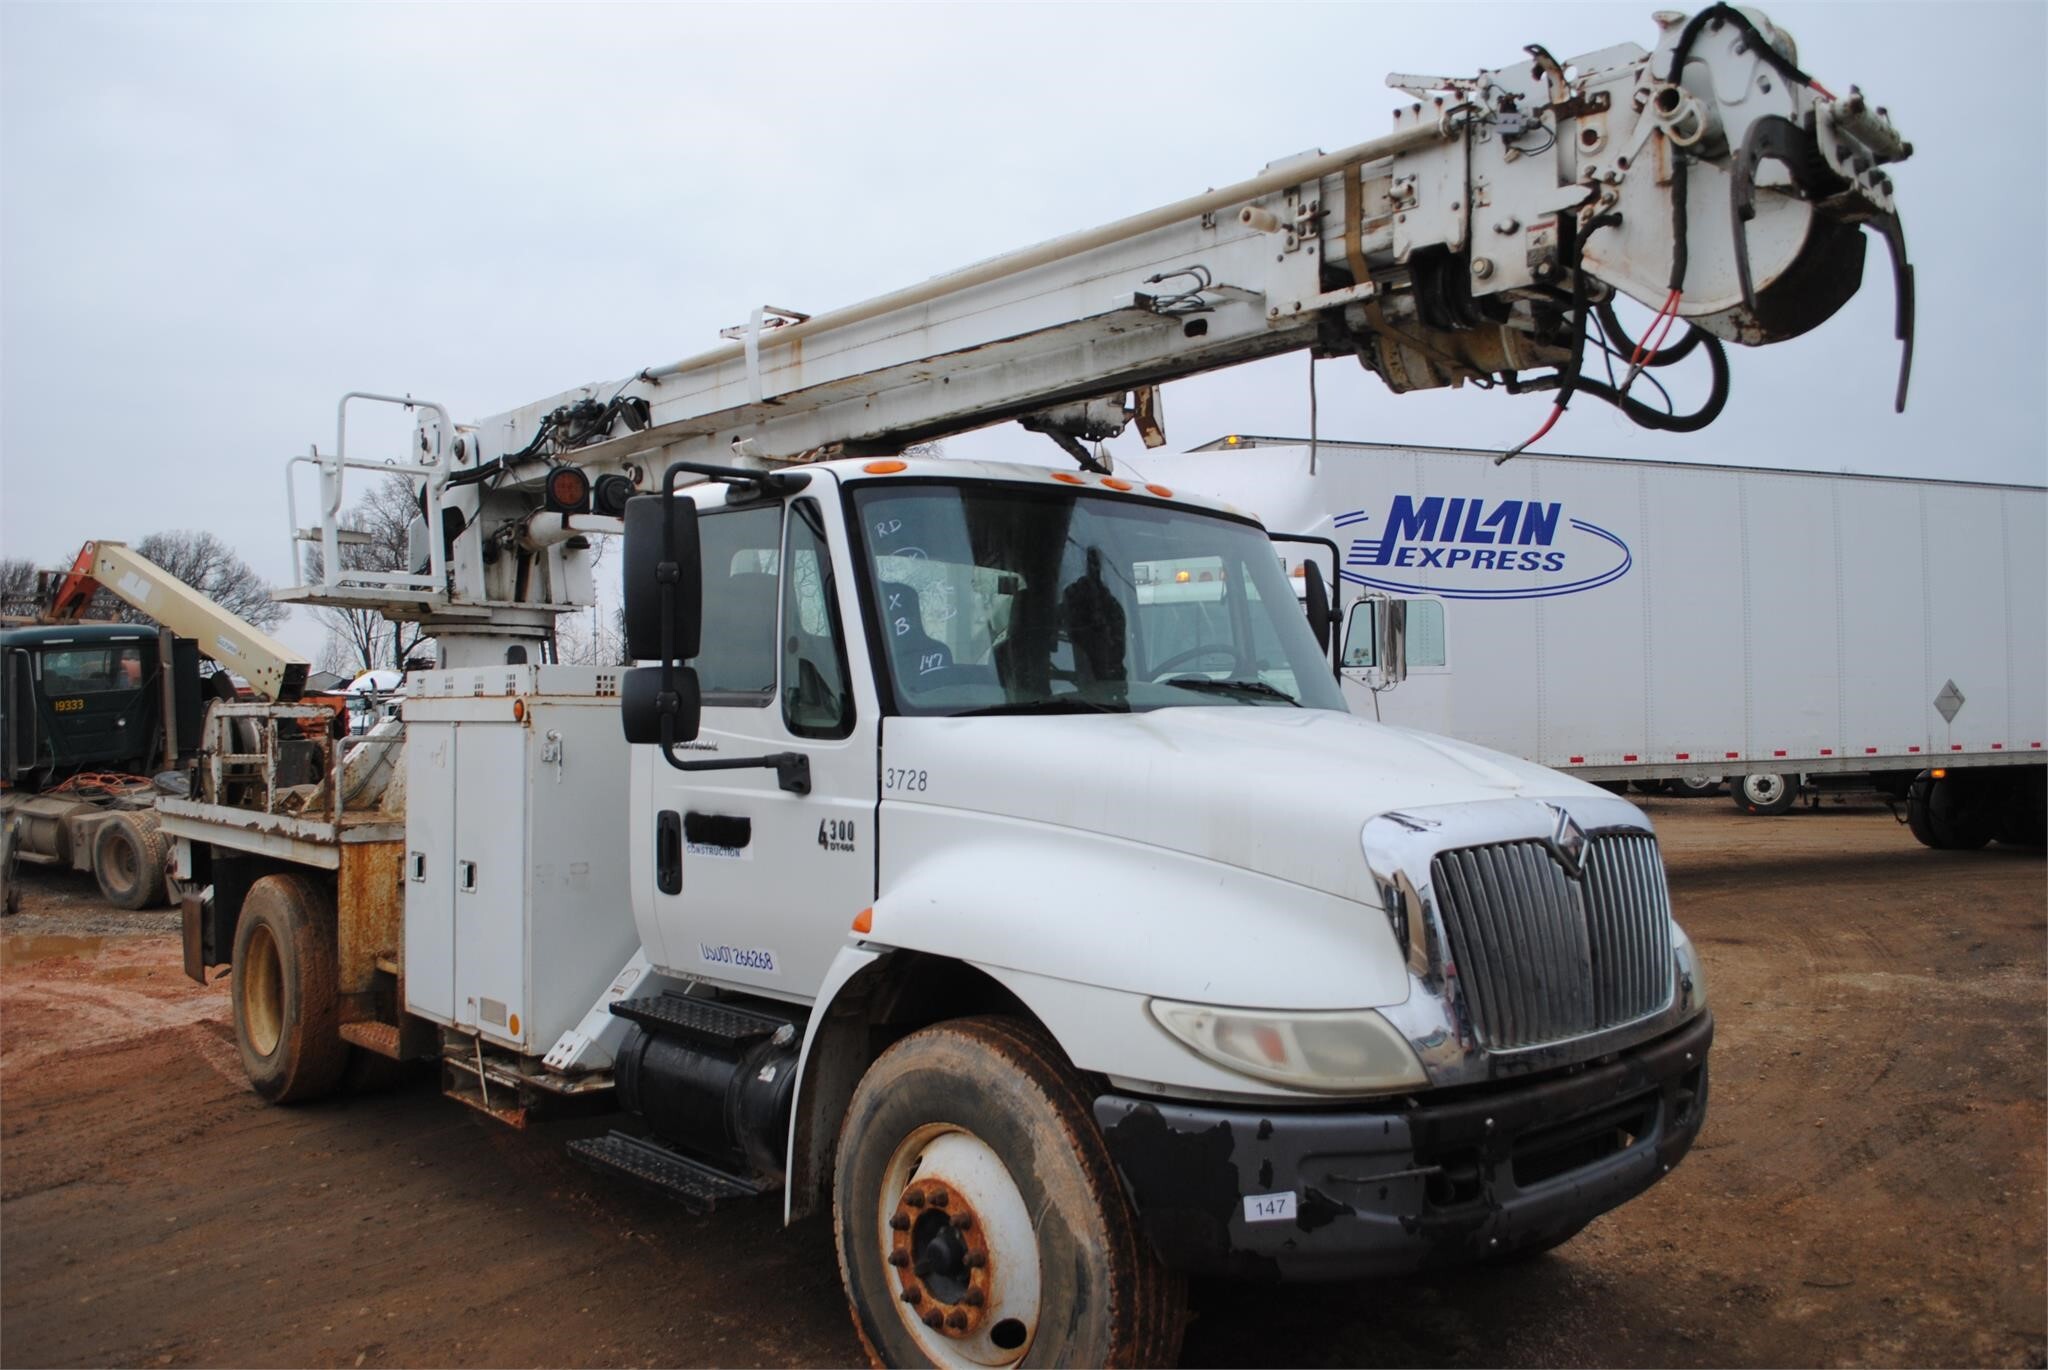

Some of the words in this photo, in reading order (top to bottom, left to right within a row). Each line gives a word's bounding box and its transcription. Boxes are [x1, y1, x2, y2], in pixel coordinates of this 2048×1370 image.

[1376, 495, 1561, 565] MILAN
[1394, 546, 1566, 572] EXPRESS
[894, 616, 911, 636] B
[919, 652, 943, 671] 147
[55, 699, 84, 712] 19333
[885, 768, 928, 792] 3728
[818, 817, 855, 850] 4300
[687, 844, 741, 857] CONSTRUCTION
[700, 942, 733, 963] USDOT
[733, 948, 773, 970] 266268
[1255, 1199, 1286, 1216] 147
